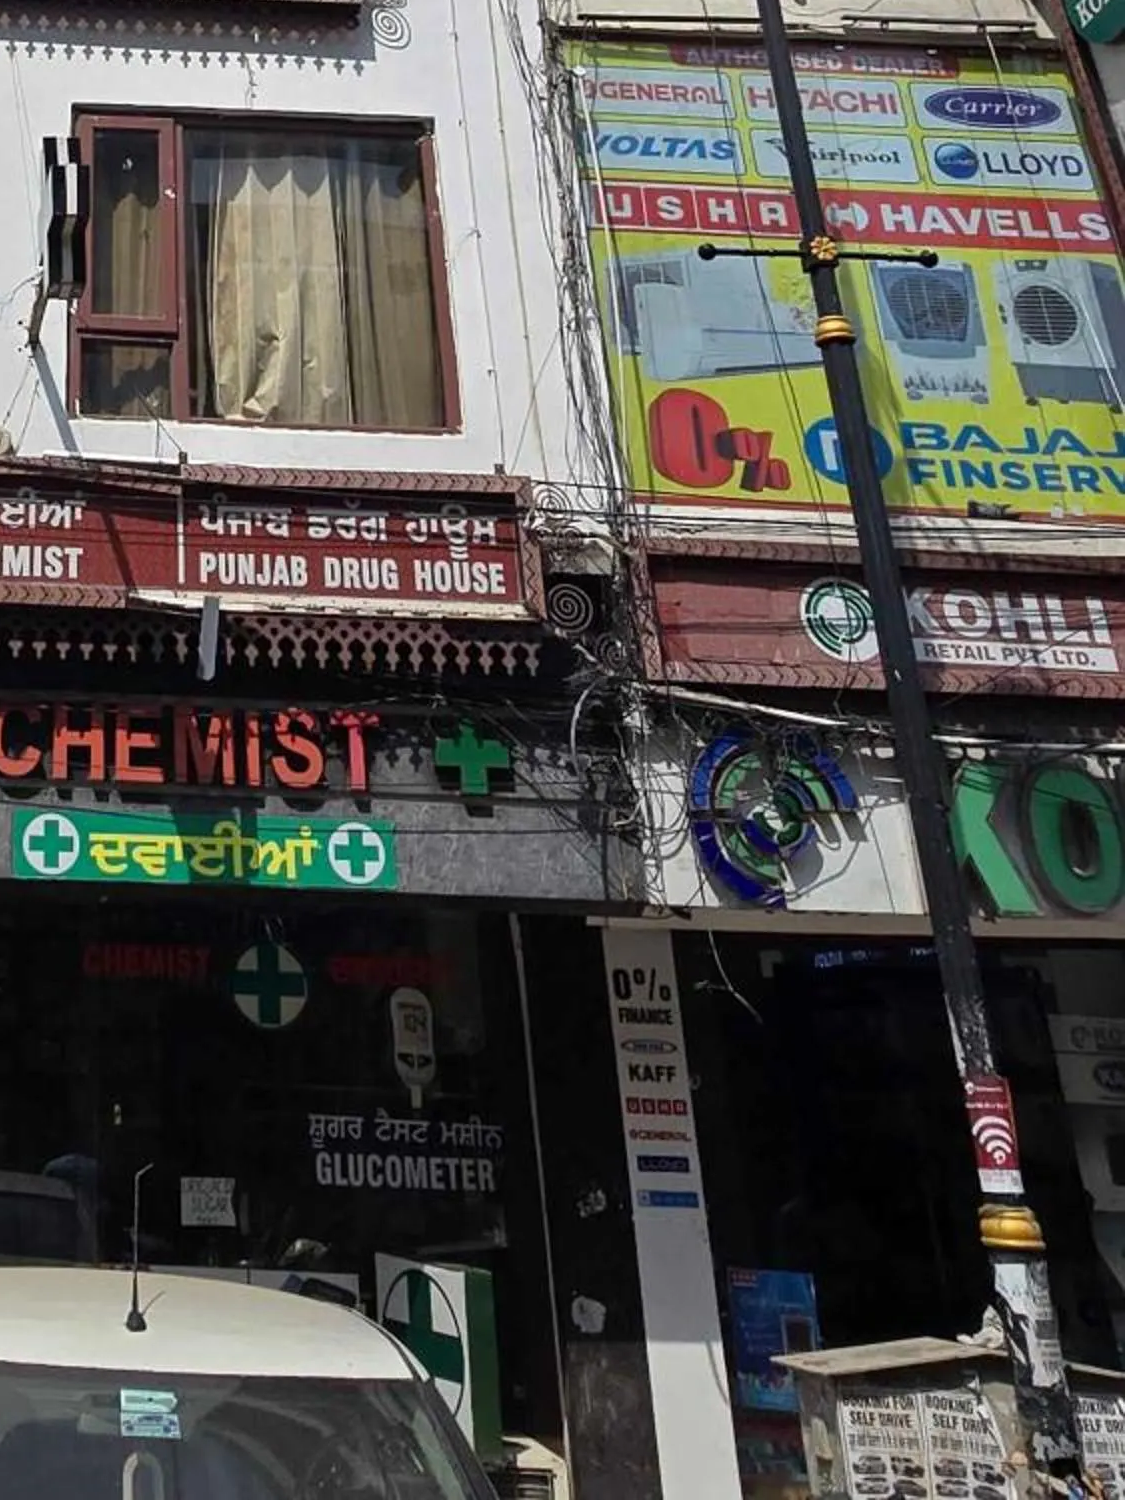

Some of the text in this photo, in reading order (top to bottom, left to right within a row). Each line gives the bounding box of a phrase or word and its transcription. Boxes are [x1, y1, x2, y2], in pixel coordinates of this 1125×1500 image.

[852, 55, 946, 75] DEALER
[747, 85, 899, 116] HACHI
[944, 98, 1043, 118] Carrier
[588, 134, 735, 161] VOLTAS
[983, 151, 1084, 178] LLOYD
[881, 203, 1112, 241] HAVELLS
[648, 387, 792, 493] 0%
[199, 552, 507, 595] PUNJAB DRUG HOUSE
[903, 586, 1112, 644] KOHLI
[923, 643, 1097, 666] RETAIL PVT. LTD.
[88, 818, 321, 880] ਦਵਾਈਆਂ
[612, 966, 672, 1002] 0%
[618, 1007, 674, 1026] FINANCE
[628, 1063, 677, 1084] KAFF
[315, 1150, 497, 1192] GLUCOMETER
[850, 1411, 912, 1429] SELF DRIVE
[932, 1413, 959, 1430] SELF
